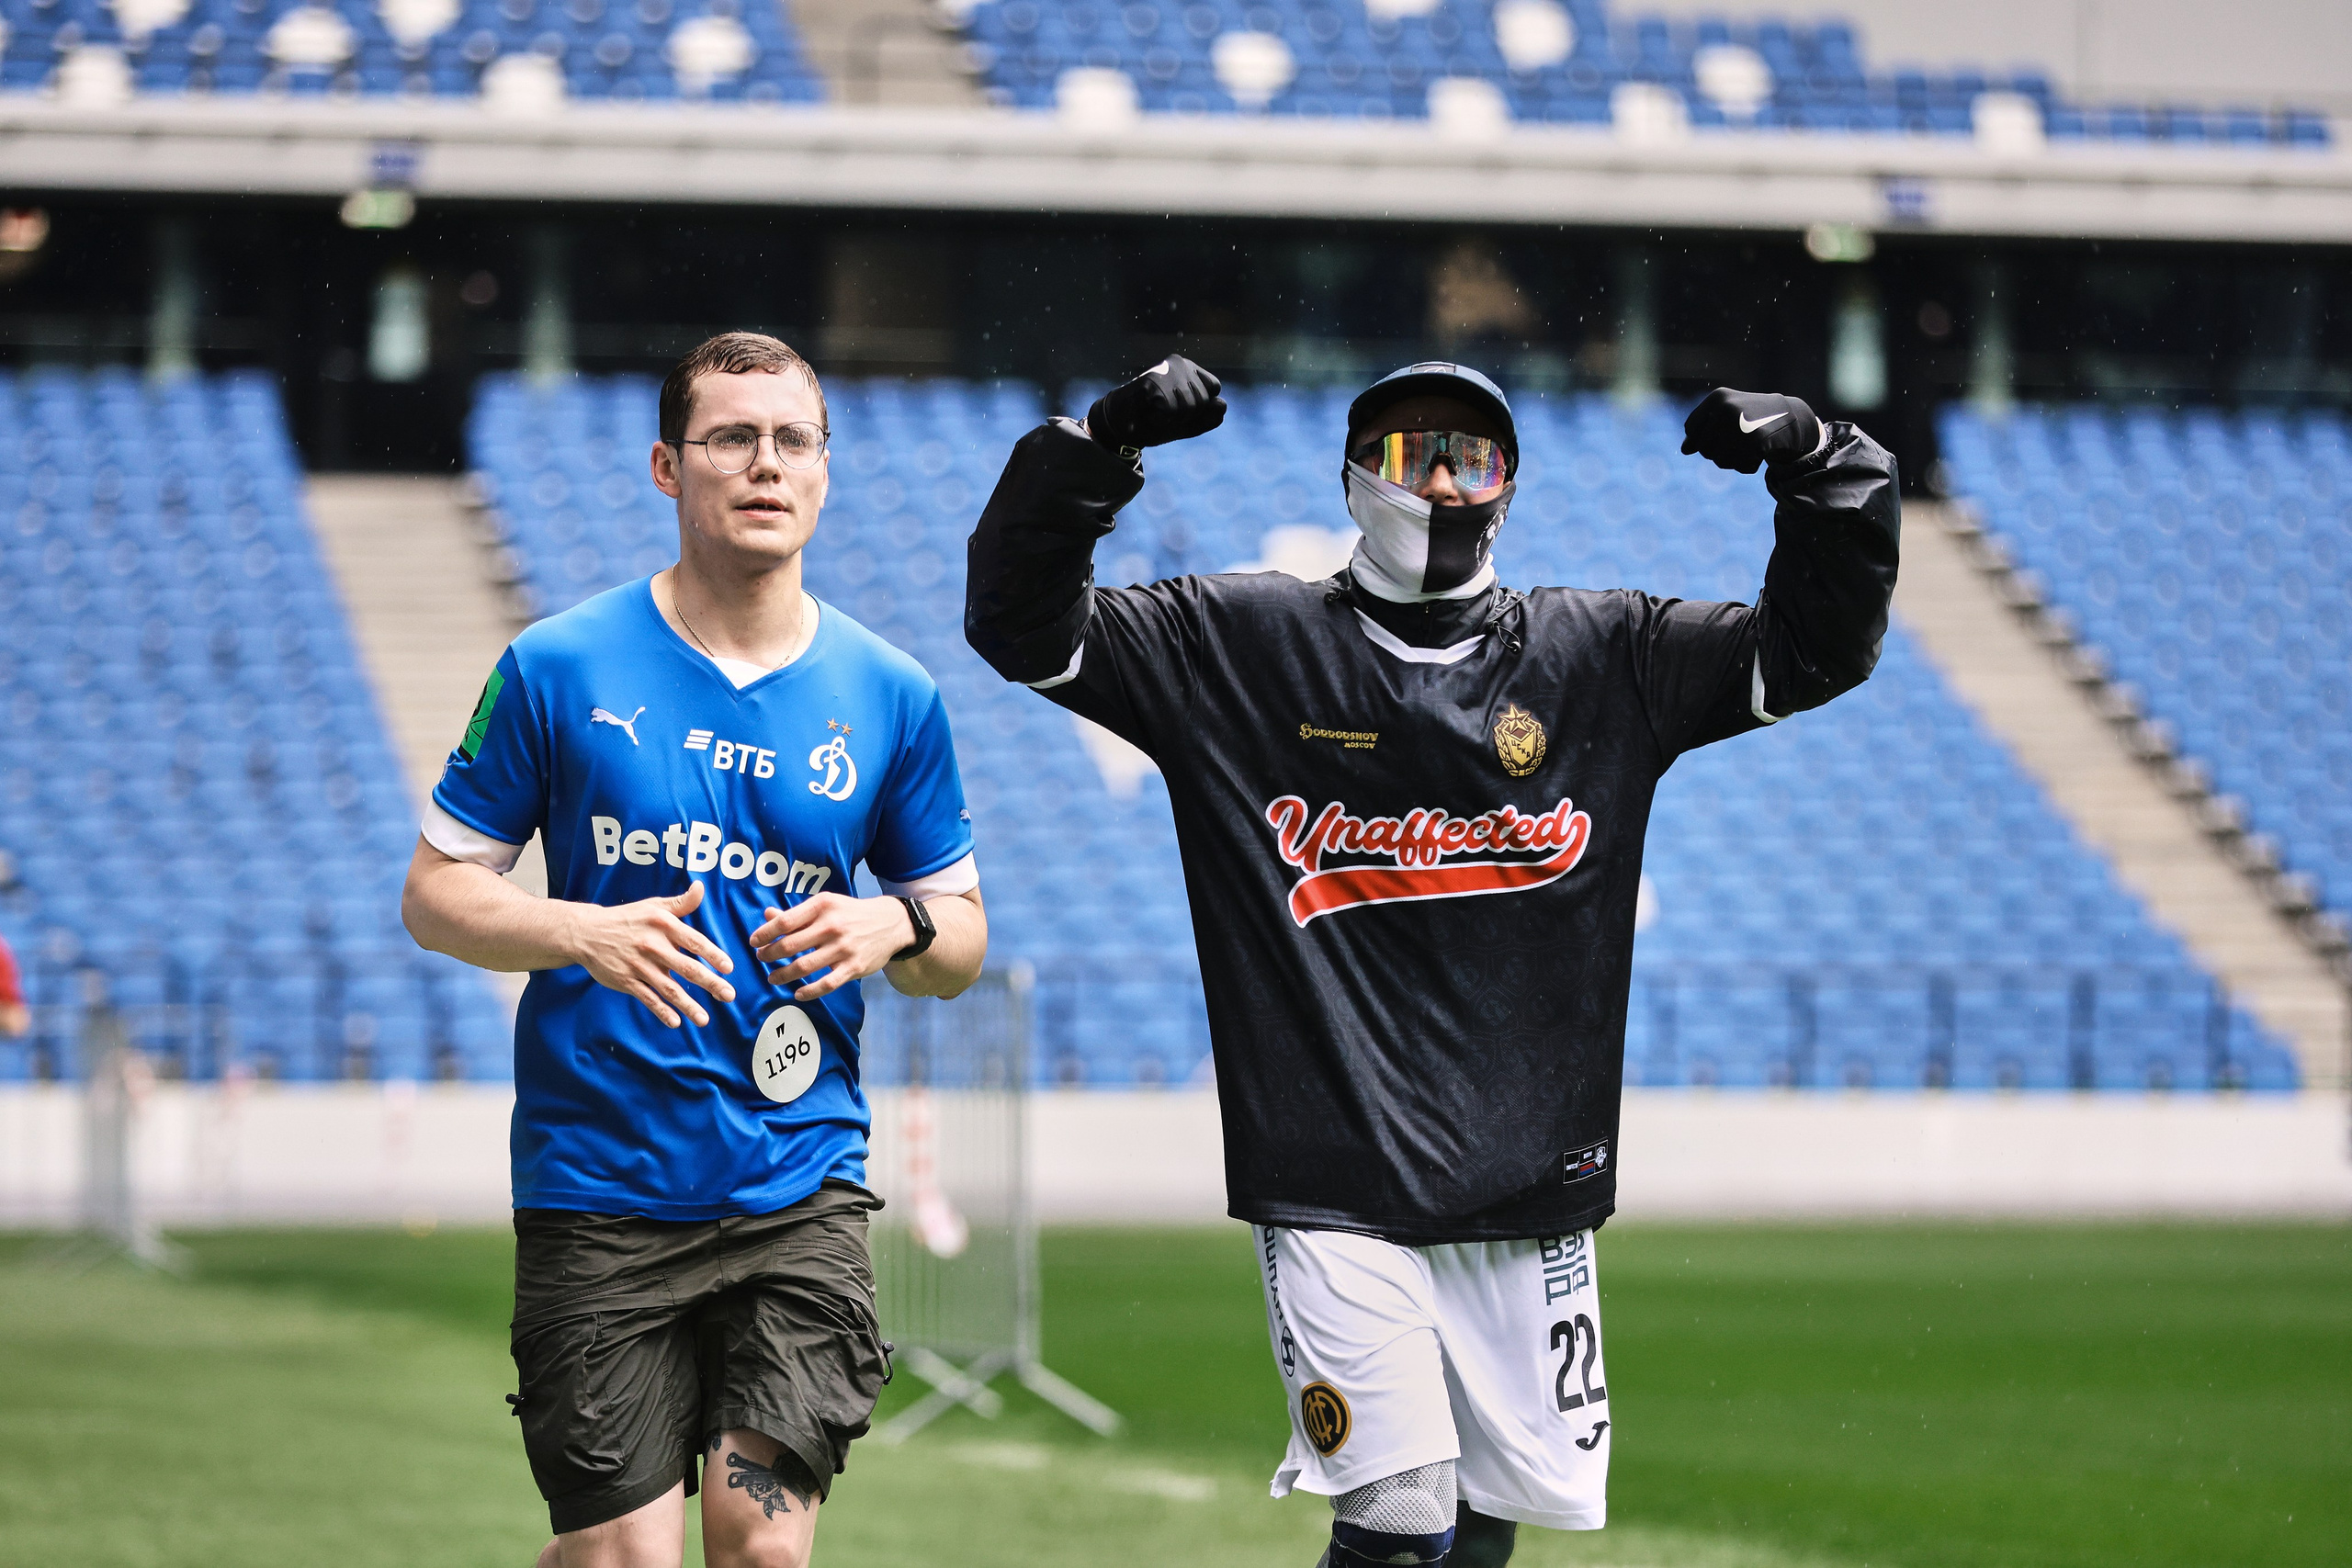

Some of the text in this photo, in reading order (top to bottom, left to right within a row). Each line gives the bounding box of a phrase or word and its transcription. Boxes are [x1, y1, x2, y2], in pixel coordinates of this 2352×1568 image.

[713, 739, 776, 779] ВТБ
[1510, 739, 1532, 759] ЦСКА
[592, 816, 832, 895] BetBoom
[1265, 795, 1589, 874] Unaffected
[765, 1035, 810, 1079] 1196
[1550, 1314, 1607, 1413] 22
